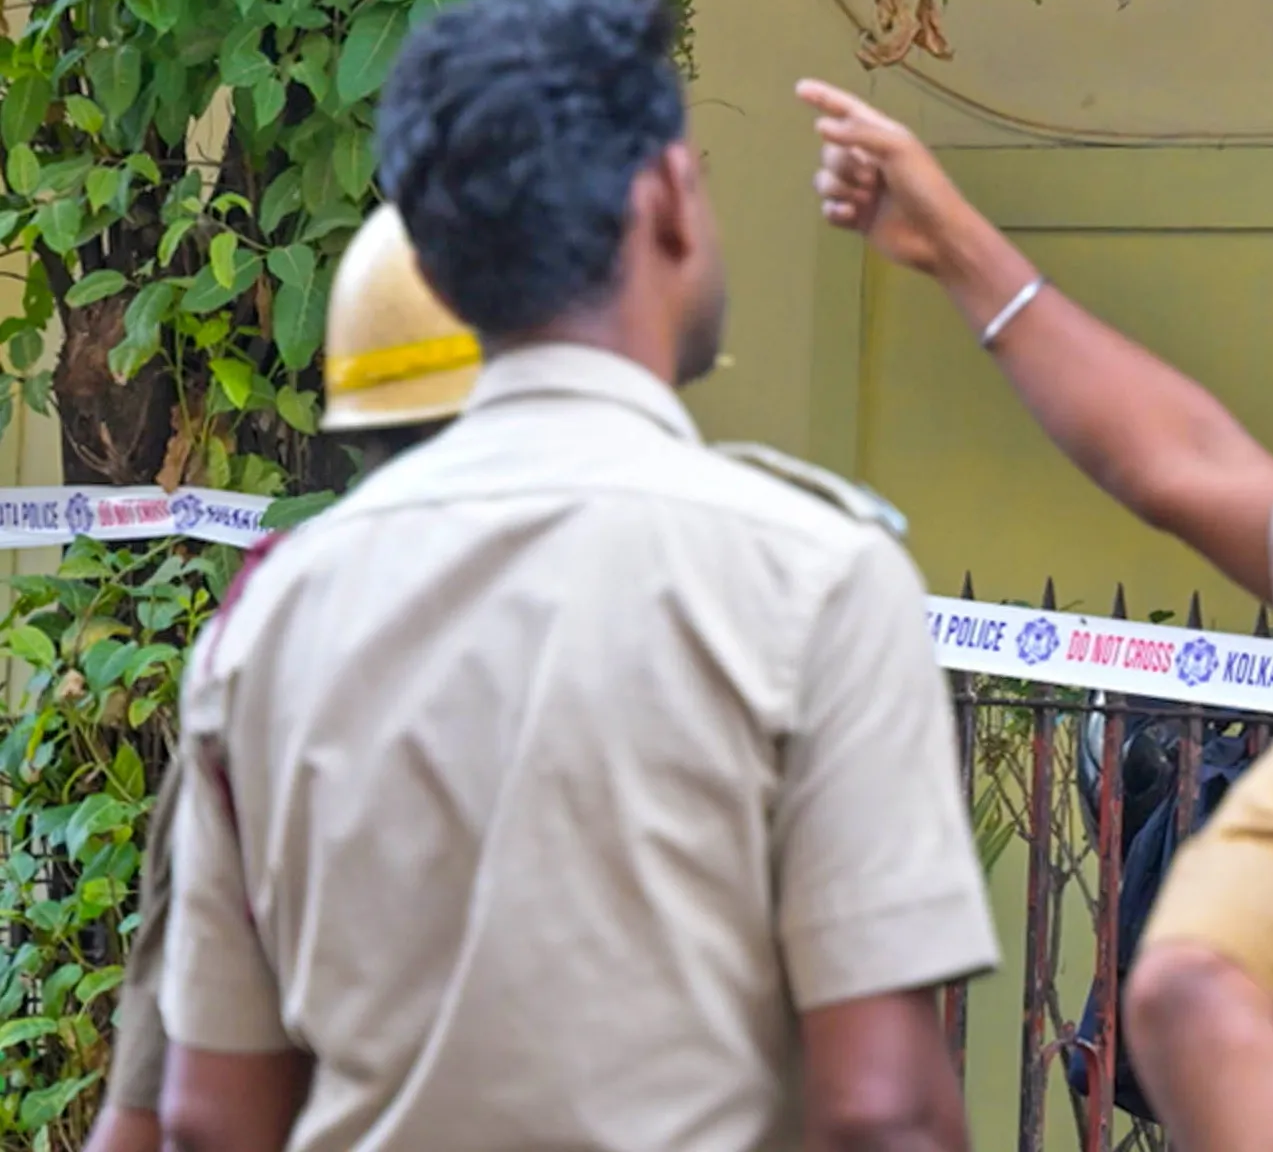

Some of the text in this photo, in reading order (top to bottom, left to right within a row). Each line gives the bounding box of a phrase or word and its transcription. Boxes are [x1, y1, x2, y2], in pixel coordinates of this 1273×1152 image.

[943, 614, 1007, 651] POLICE
[1066, 629, 1091, 662] DO
[1091, 634, 1125, 667] NOT
[1123, 637, 1176, 674] CROSS
